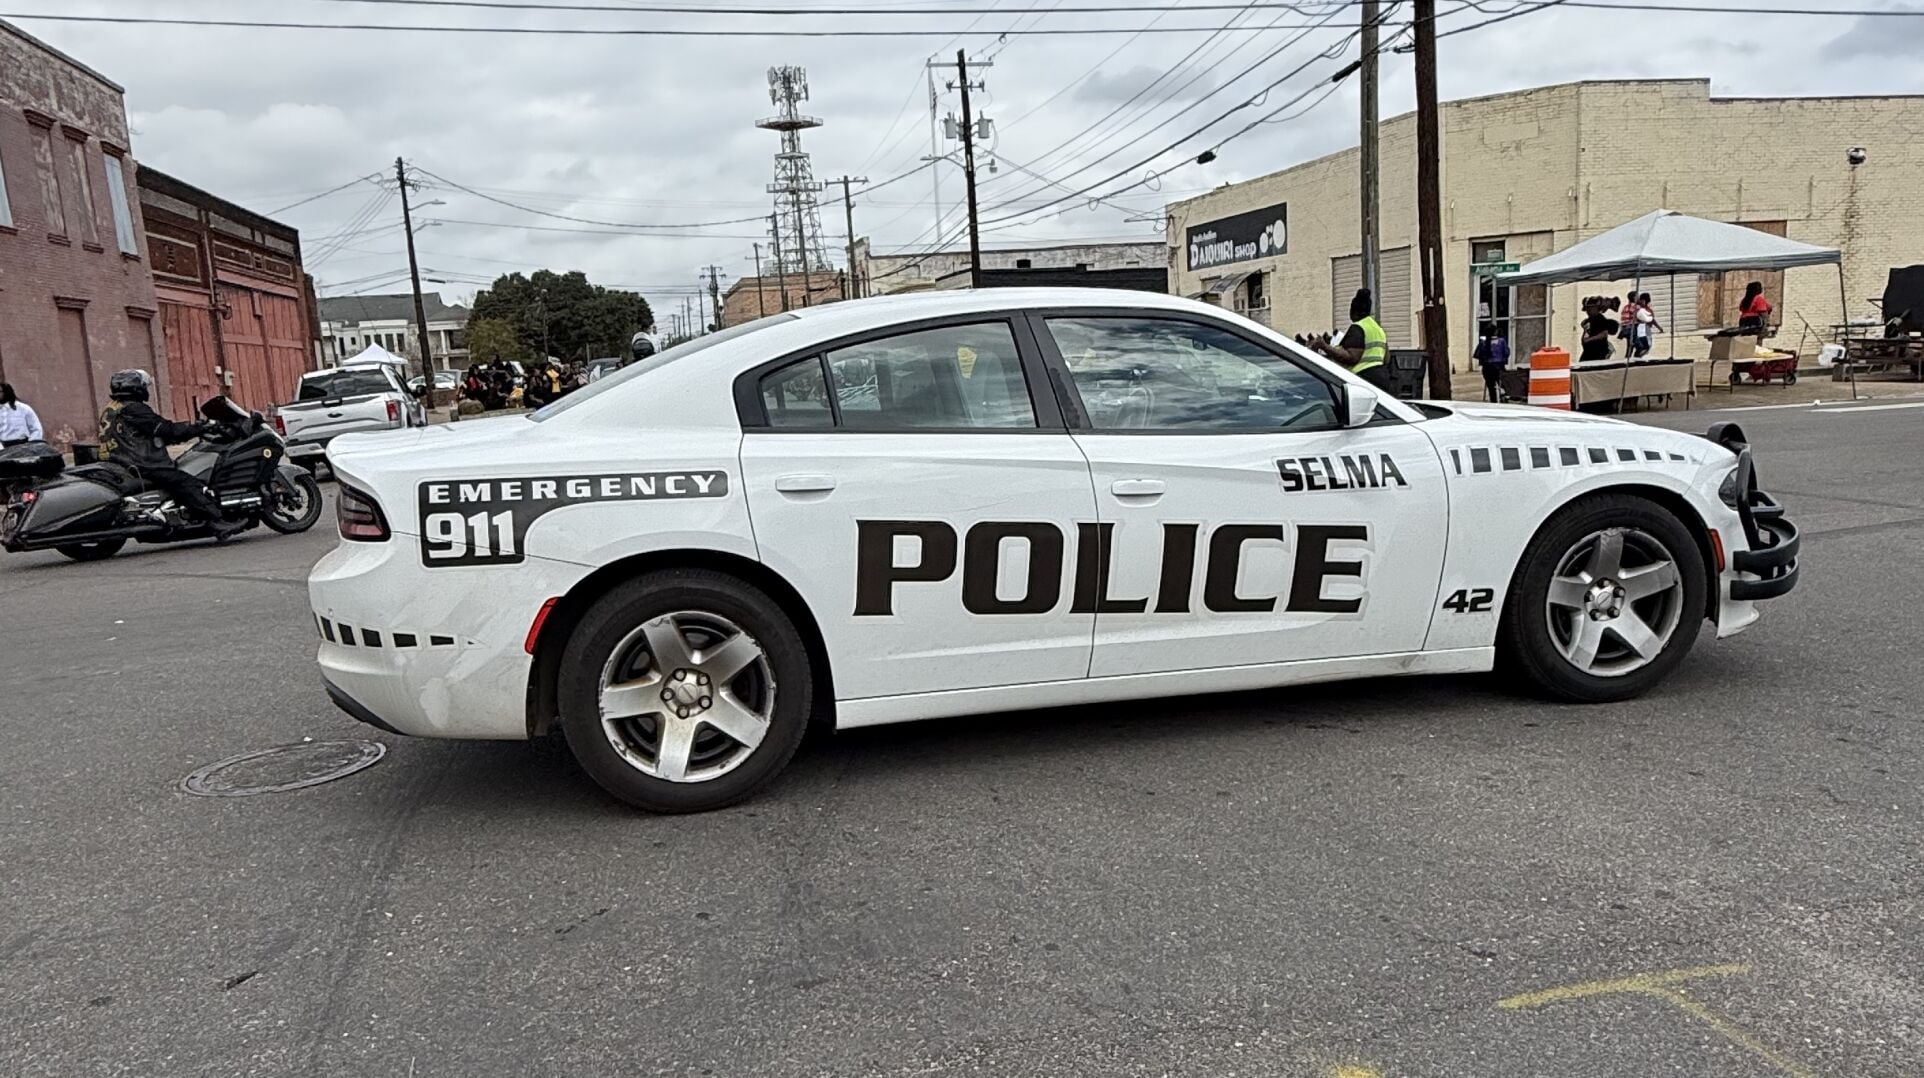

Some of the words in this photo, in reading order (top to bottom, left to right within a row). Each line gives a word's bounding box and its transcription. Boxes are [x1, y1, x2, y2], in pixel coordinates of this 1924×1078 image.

[1234, 242, 1257, 258] SHOP
[428, 474, 716, 504] EMERGENCY
[1276, 453, 1408, 492] SELMA
[425, 509, 517, 559] 911
[852, 519, 1369, 616] POLICE
[1442, 588, 1494, 613] 42
